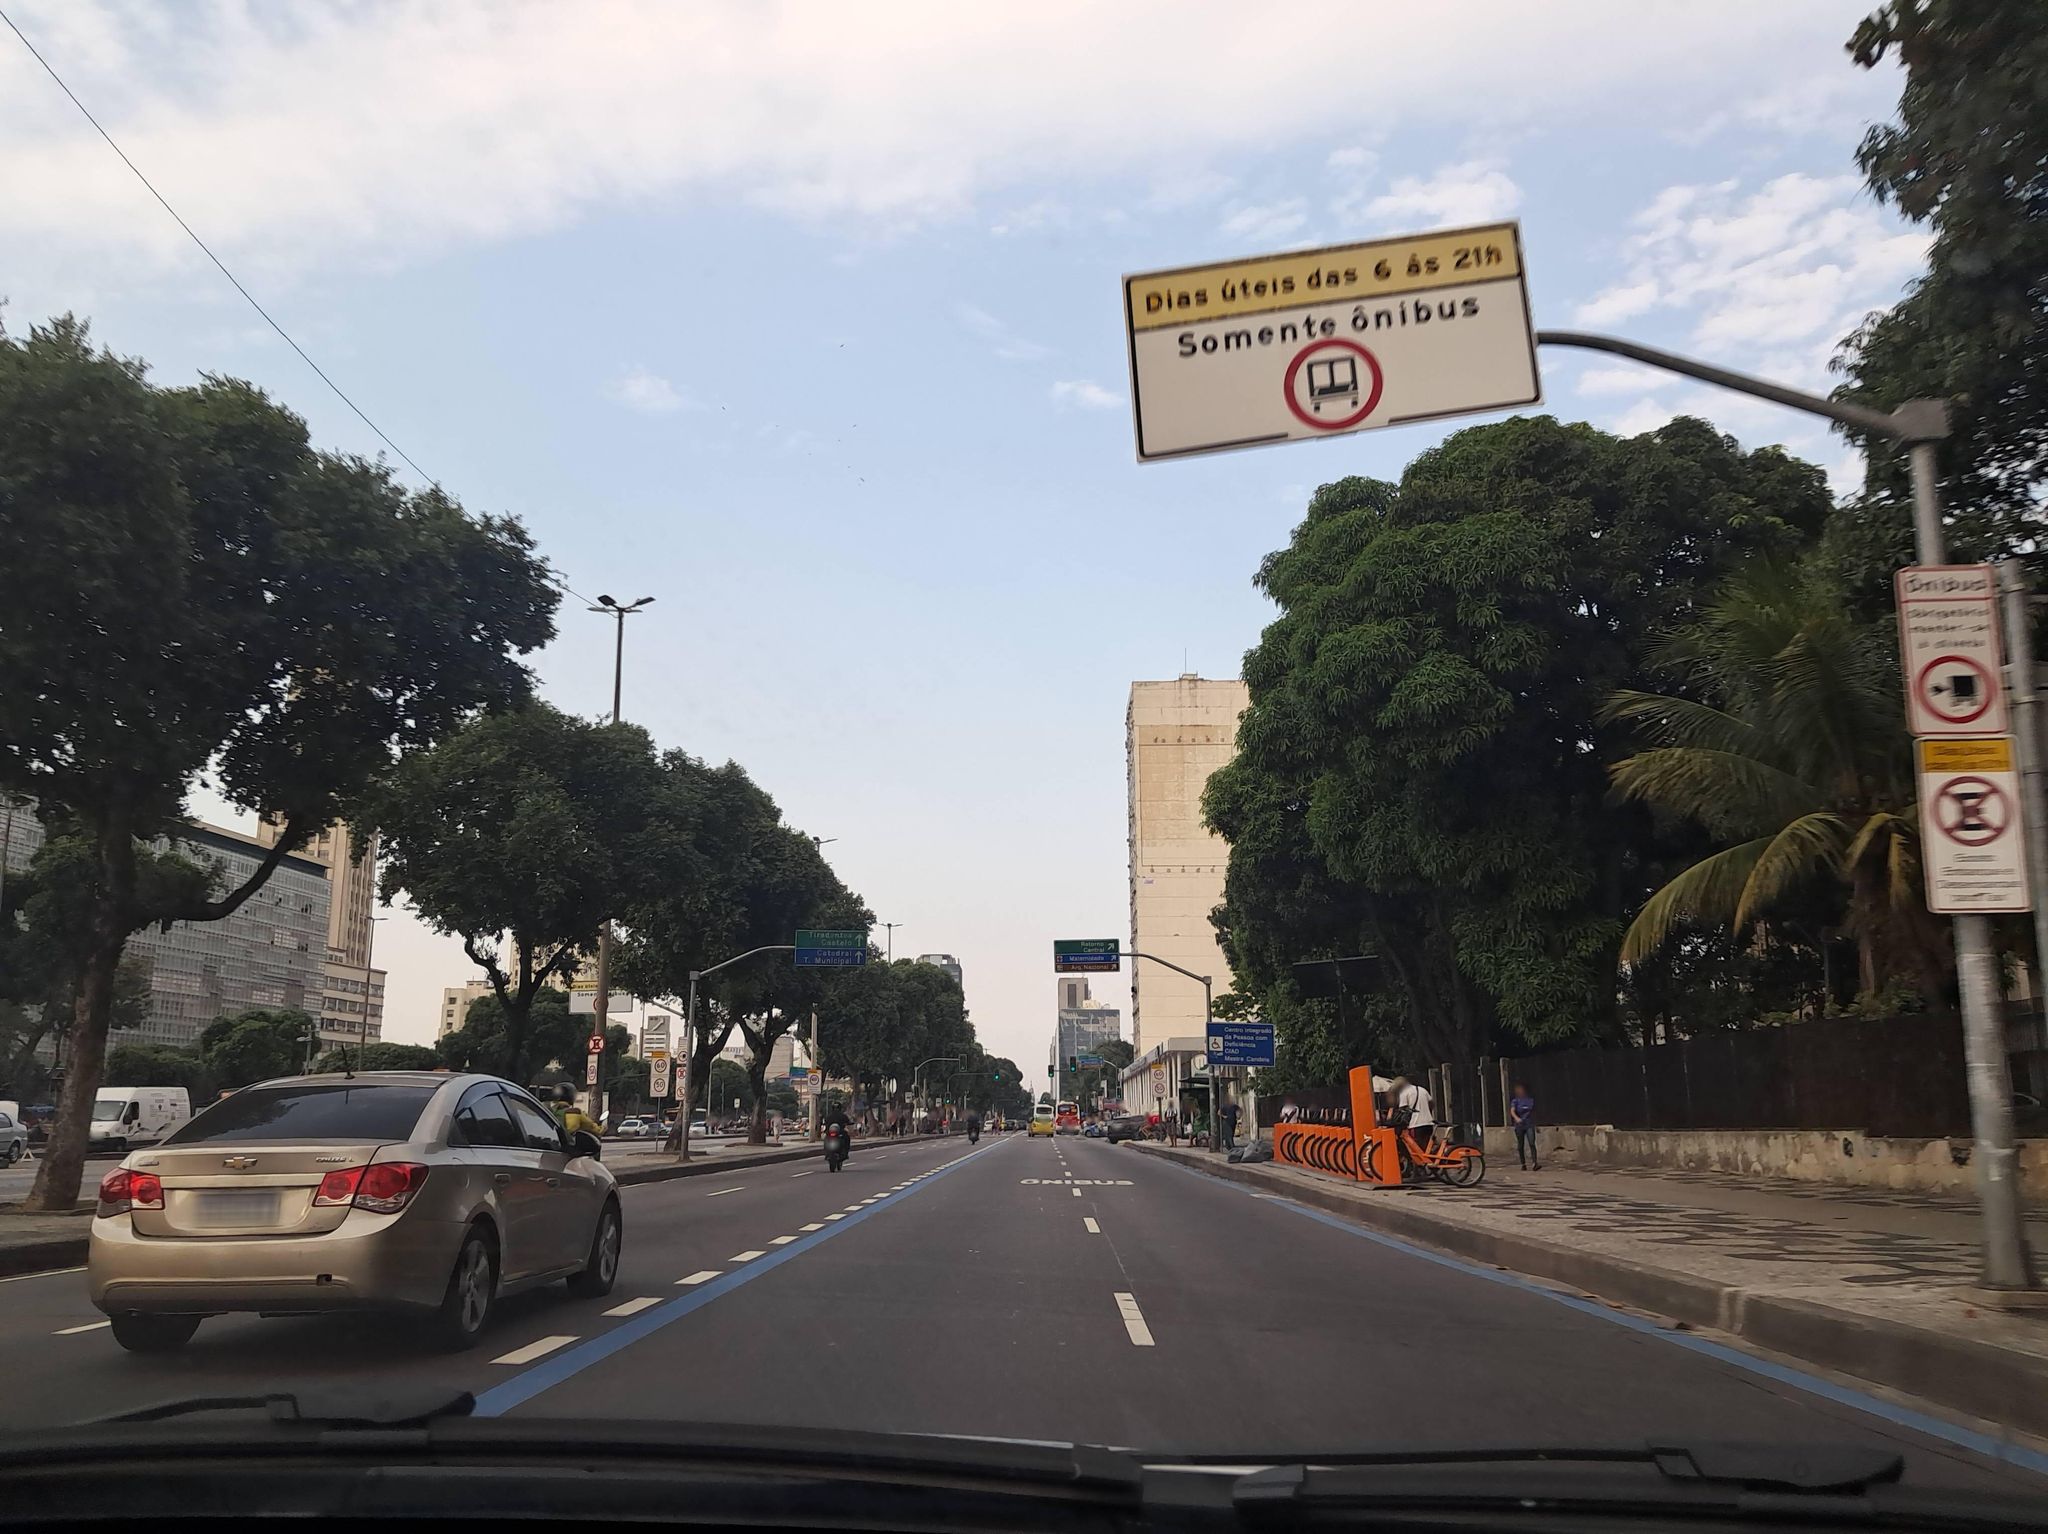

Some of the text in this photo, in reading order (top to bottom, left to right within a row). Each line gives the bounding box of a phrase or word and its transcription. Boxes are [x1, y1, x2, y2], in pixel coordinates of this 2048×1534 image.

[1145, 289, 1208, 314] Dias
[1221, 275, 1296, 303] úteis
[1306, 266, 1359, 290] das
[1373, 258, 1393, 282] 6
[1452, 243, 1504, 271] 21h
[1177, 294, 1481, 359] Somente ônibus
[815, 957, 852, 966] Municipal
